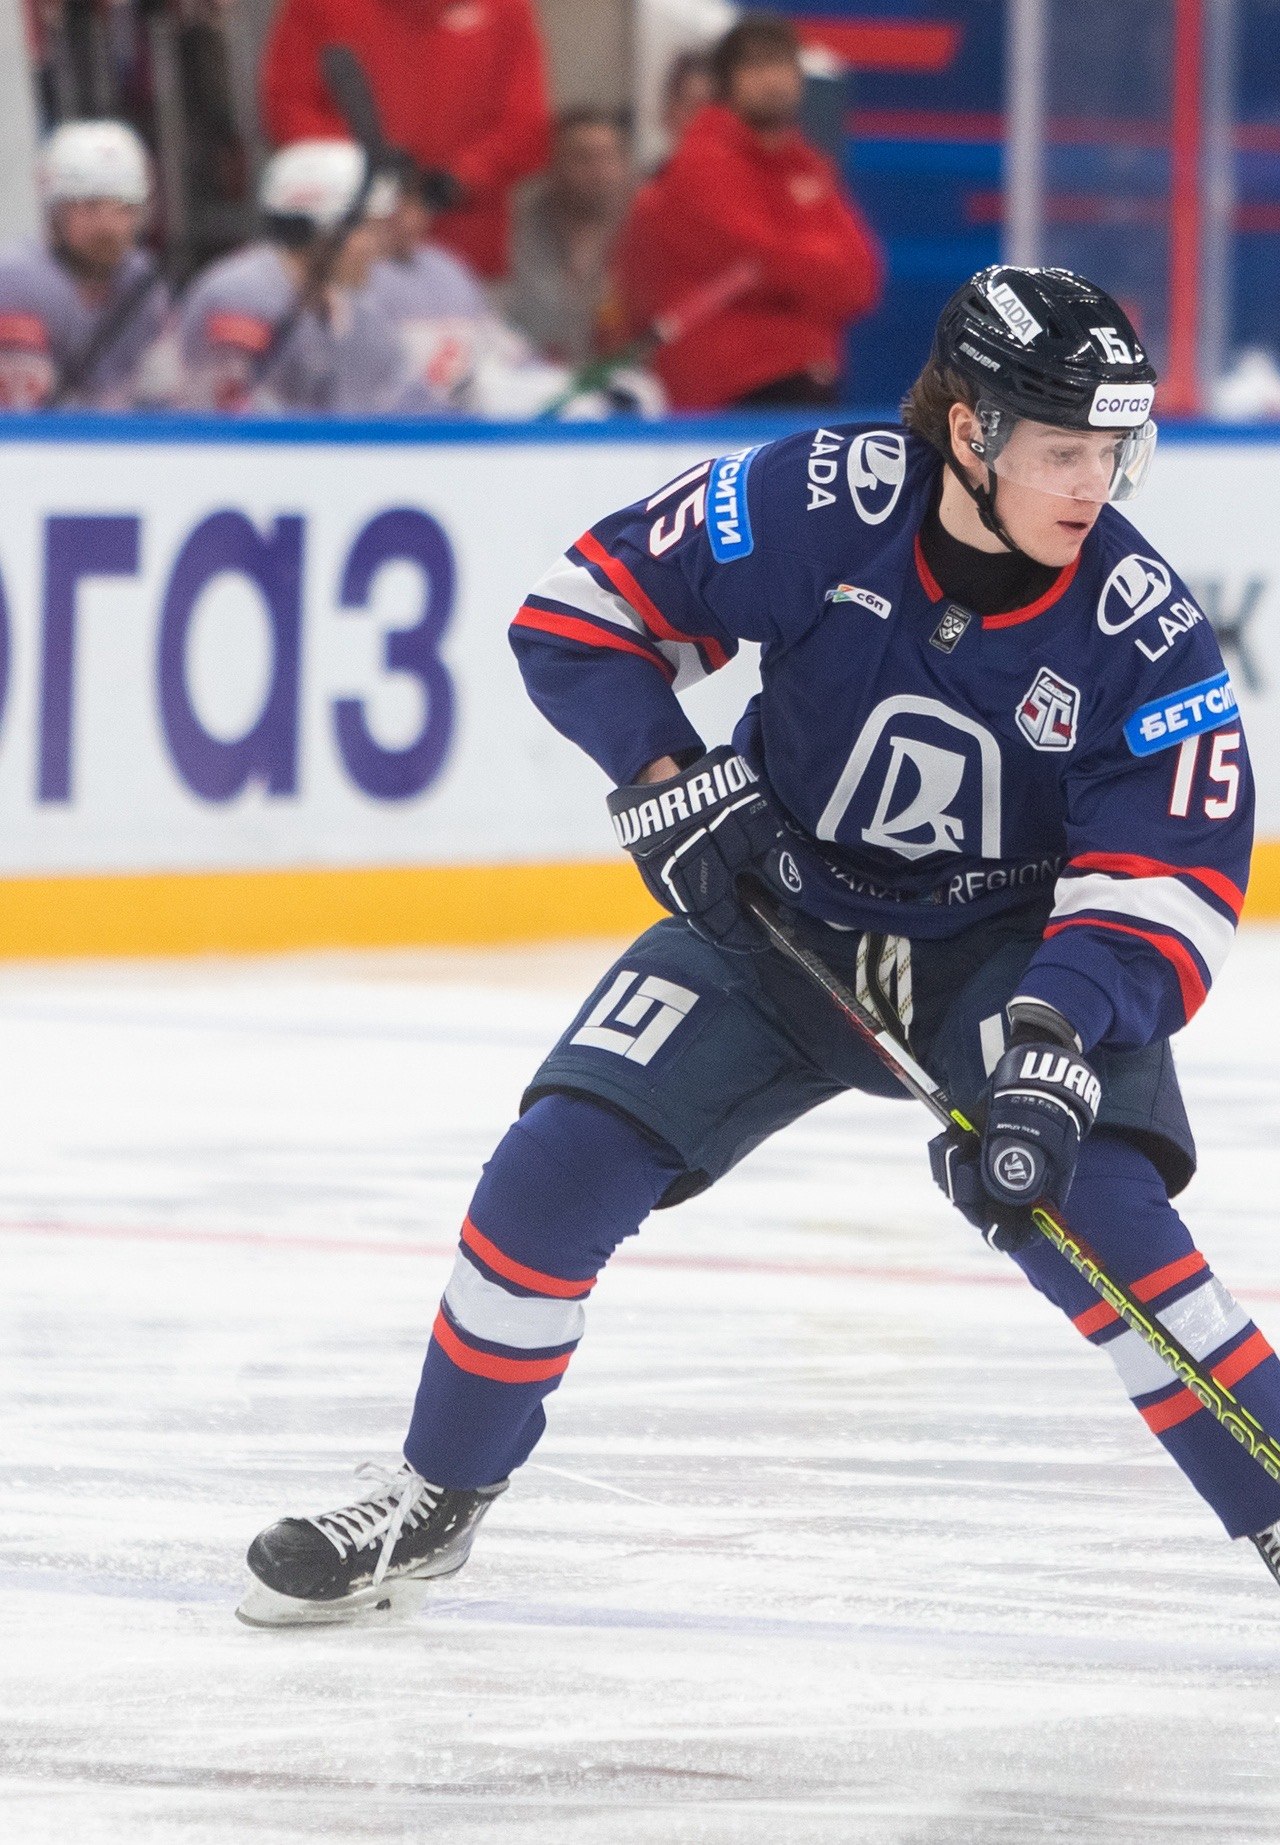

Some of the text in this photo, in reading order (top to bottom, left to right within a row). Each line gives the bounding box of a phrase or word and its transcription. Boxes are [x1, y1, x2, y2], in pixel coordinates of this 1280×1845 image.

[992, 287, 1034, 337] LADA
[1089, 327, 1133, 364] 15
[959, 342, 1000, 373] BAUER
[807, 428, 845, 511] LADA
[645, 460, 711, 557] 15
[0, 505, 457, 805] газ
[1134, 597, 1203, 662] LADA
[1170, 731, 1240, 819] 15
